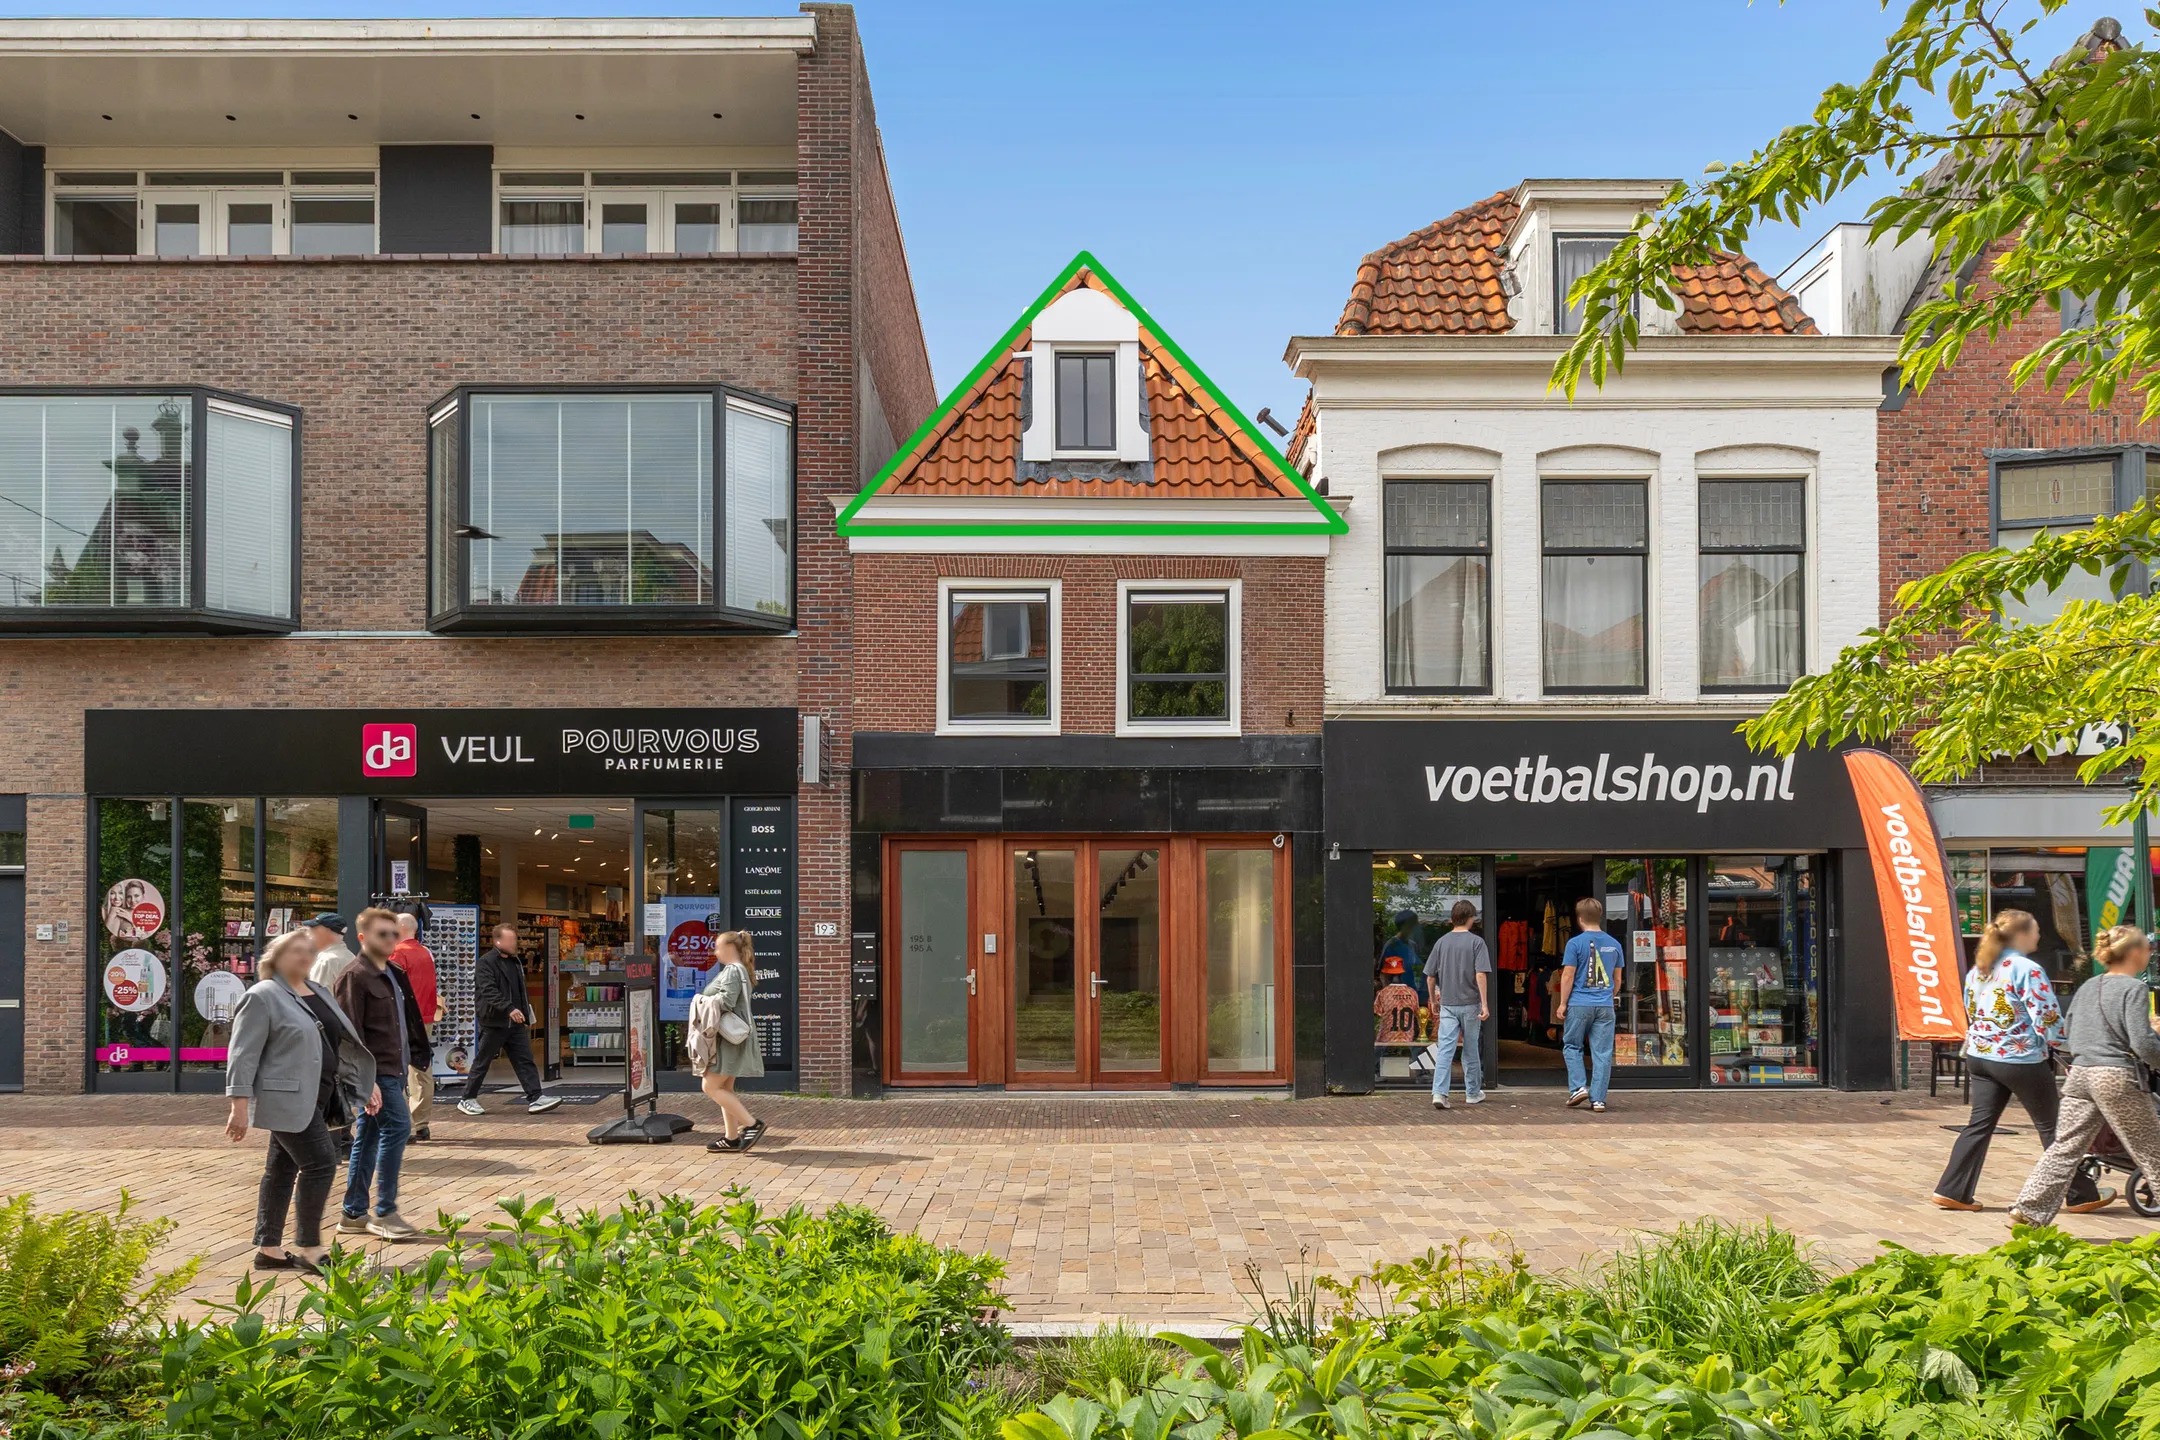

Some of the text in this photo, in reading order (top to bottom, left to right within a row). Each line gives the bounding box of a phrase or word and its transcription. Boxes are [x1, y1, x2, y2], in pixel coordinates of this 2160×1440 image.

[562, 729, 760, 754] POURVOUS
[365, 730, 411, 769] da
[440, 736, 535, 764] VEUL
[605, 758, 724, 770] PARFUMERIE
[1425, 753, 1795, 813] voetbalshop.nl
[751, 825, 775, 833] BOSS
[745, 866, 782, 874] LANCÔME
[745, 908, 782, 917] CLINIQUE
[1880, 803, 1953, 1027] voetbalshop.nl
[816, 924, 836, 934] 193
[671, 935, 717, 950] -25%
[910, 935, 933, 943] 195 B
[910, 944, 933, 952] 195 A
[1809, 944, 1818, 982] CUP
[626, 962, 653, 979] WELKOM
[114, 986, 138, 995] -25%
[1389, 1006, 1415, 1032] 10
[109, 1046, 129, 1062] da
[1753, 1046, 1796, 1057] TUNISIA
[1787, 1073, 1816, 1081] HOLLAND
